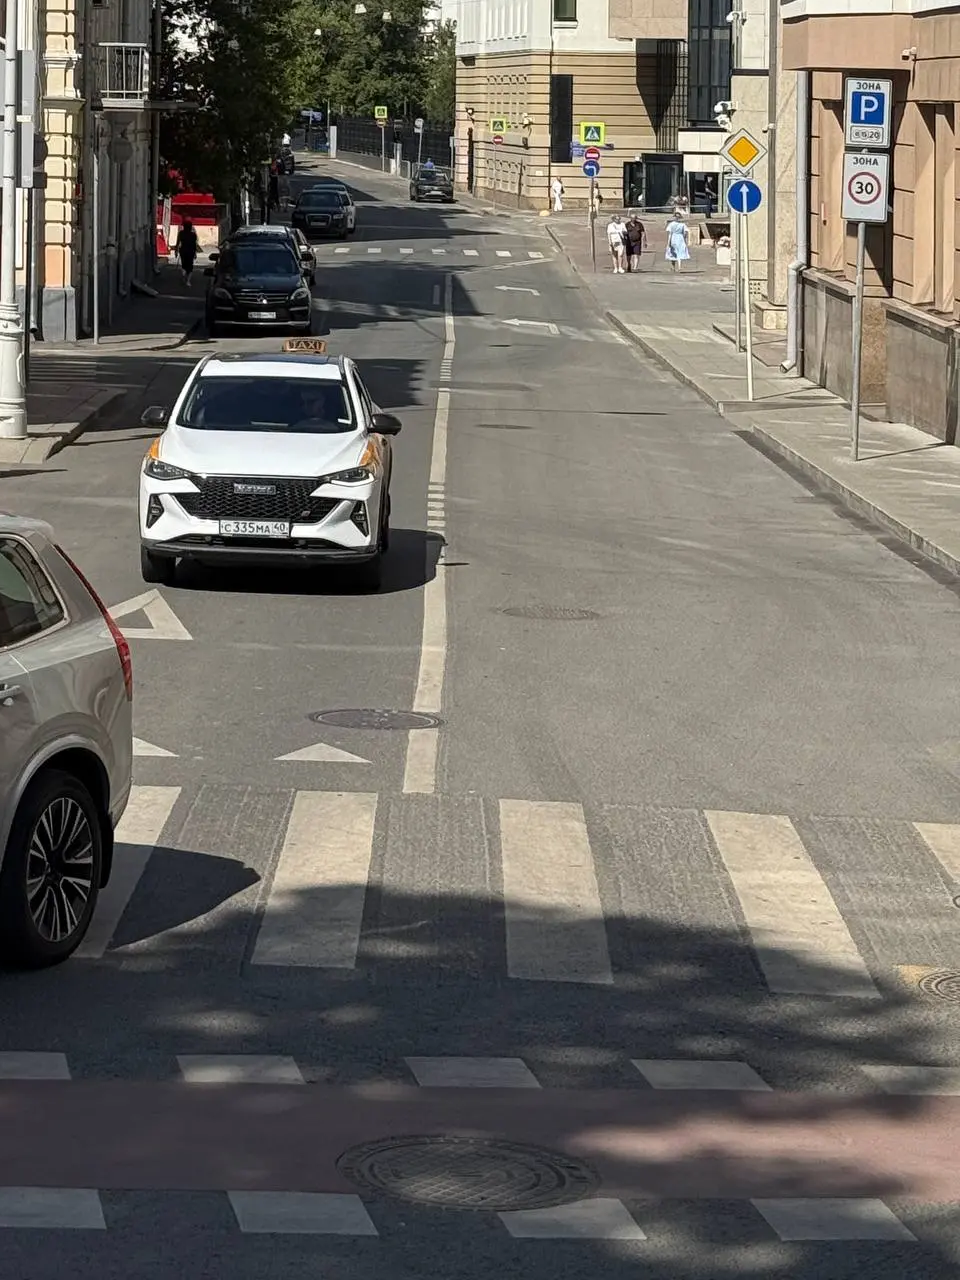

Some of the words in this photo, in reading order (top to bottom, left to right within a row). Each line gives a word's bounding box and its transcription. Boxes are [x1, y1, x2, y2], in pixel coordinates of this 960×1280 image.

[856, 81, 881, 91] ЗОНА
[860, 95, 879, 121] P
[852, 156, 879, 166] ЗОНА
[855, 181, 874, 195] 30
[290, 340, 320, 350] TAXI
